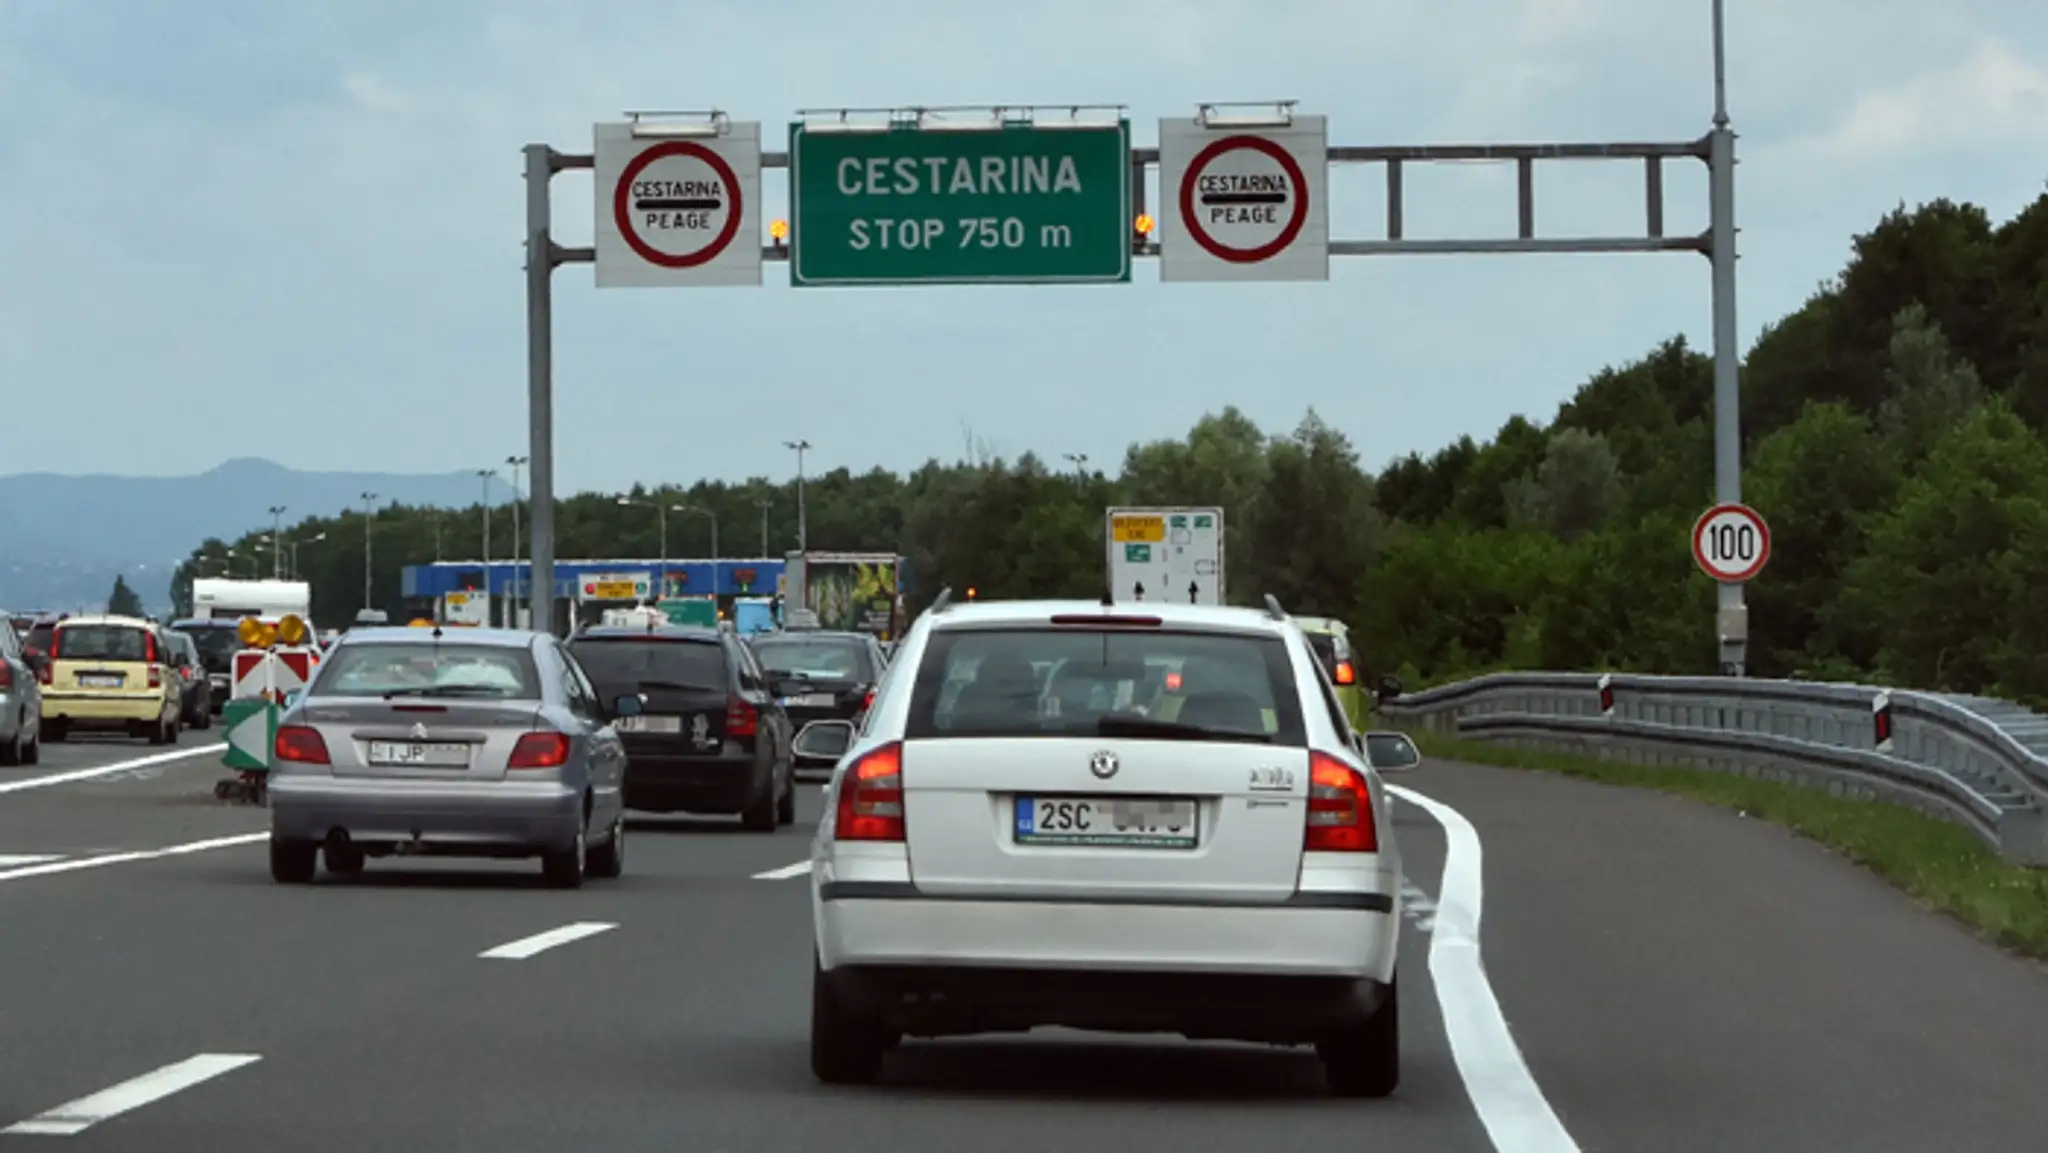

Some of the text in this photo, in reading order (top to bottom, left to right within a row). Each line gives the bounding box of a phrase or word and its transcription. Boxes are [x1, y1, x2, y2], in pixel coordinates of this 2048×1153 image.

[837, 155, 1082, 195] CESTARINA
[1199, 175, 1288, 192] CESTARINA
[632, 181, 721, 198] CESTARINA
[646, 212, 711, 230] PEAGE
[1210, 206, 1277, 223] PEAGE
[848, 216, 1071, 250] STOP 750 m
[1709, 524, 1755, 561] 100
[1040, 802, 1091, 831] 2SC
